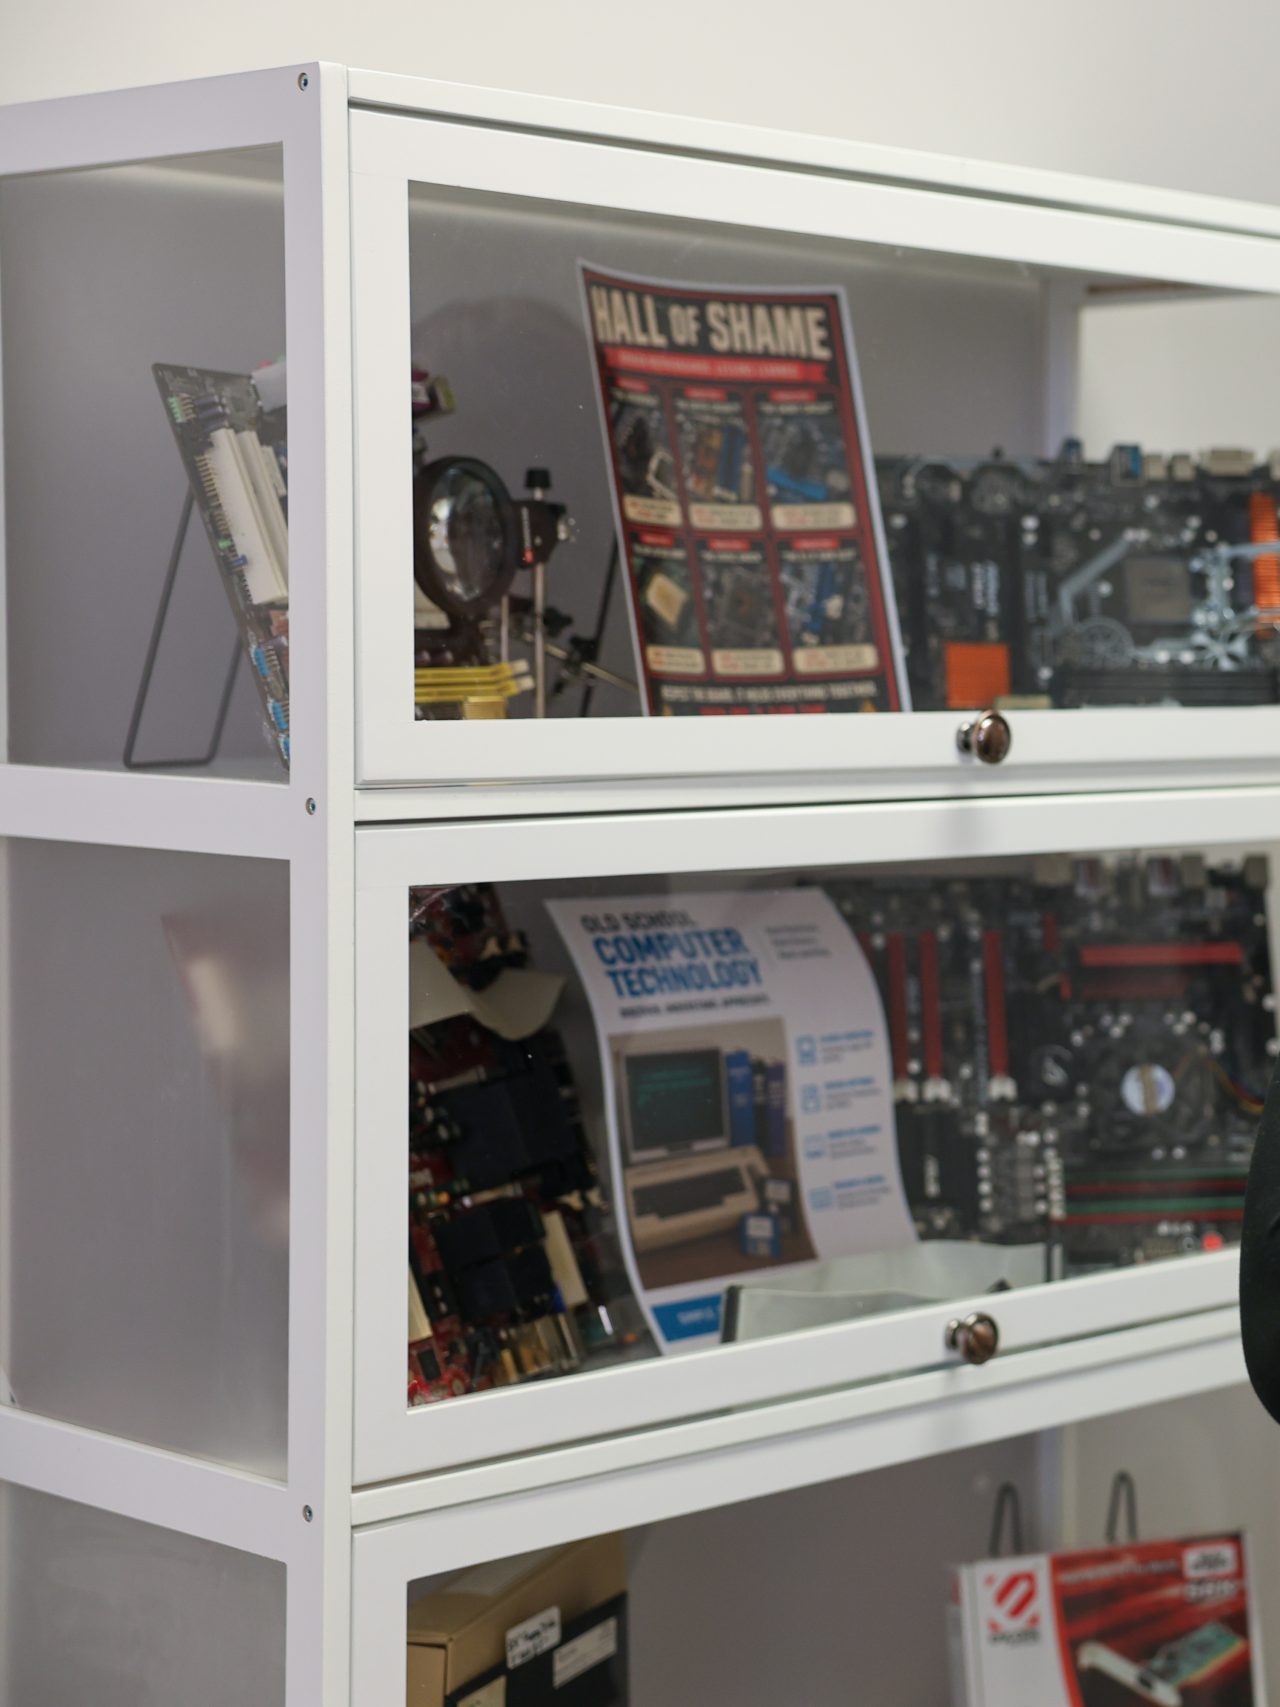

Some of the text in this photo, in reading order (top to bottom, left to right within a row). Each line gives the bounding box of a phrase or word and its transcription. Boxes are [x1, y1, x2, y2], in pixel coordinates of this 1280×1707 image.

[592, 287, 831, 360] HALL OF SHAME
[580, 910, 696, 933] OLD SCHOOL
[593, 927, 750, 965] COMPUTER
[606, 959, 762, 999] TECHNOLOGY
